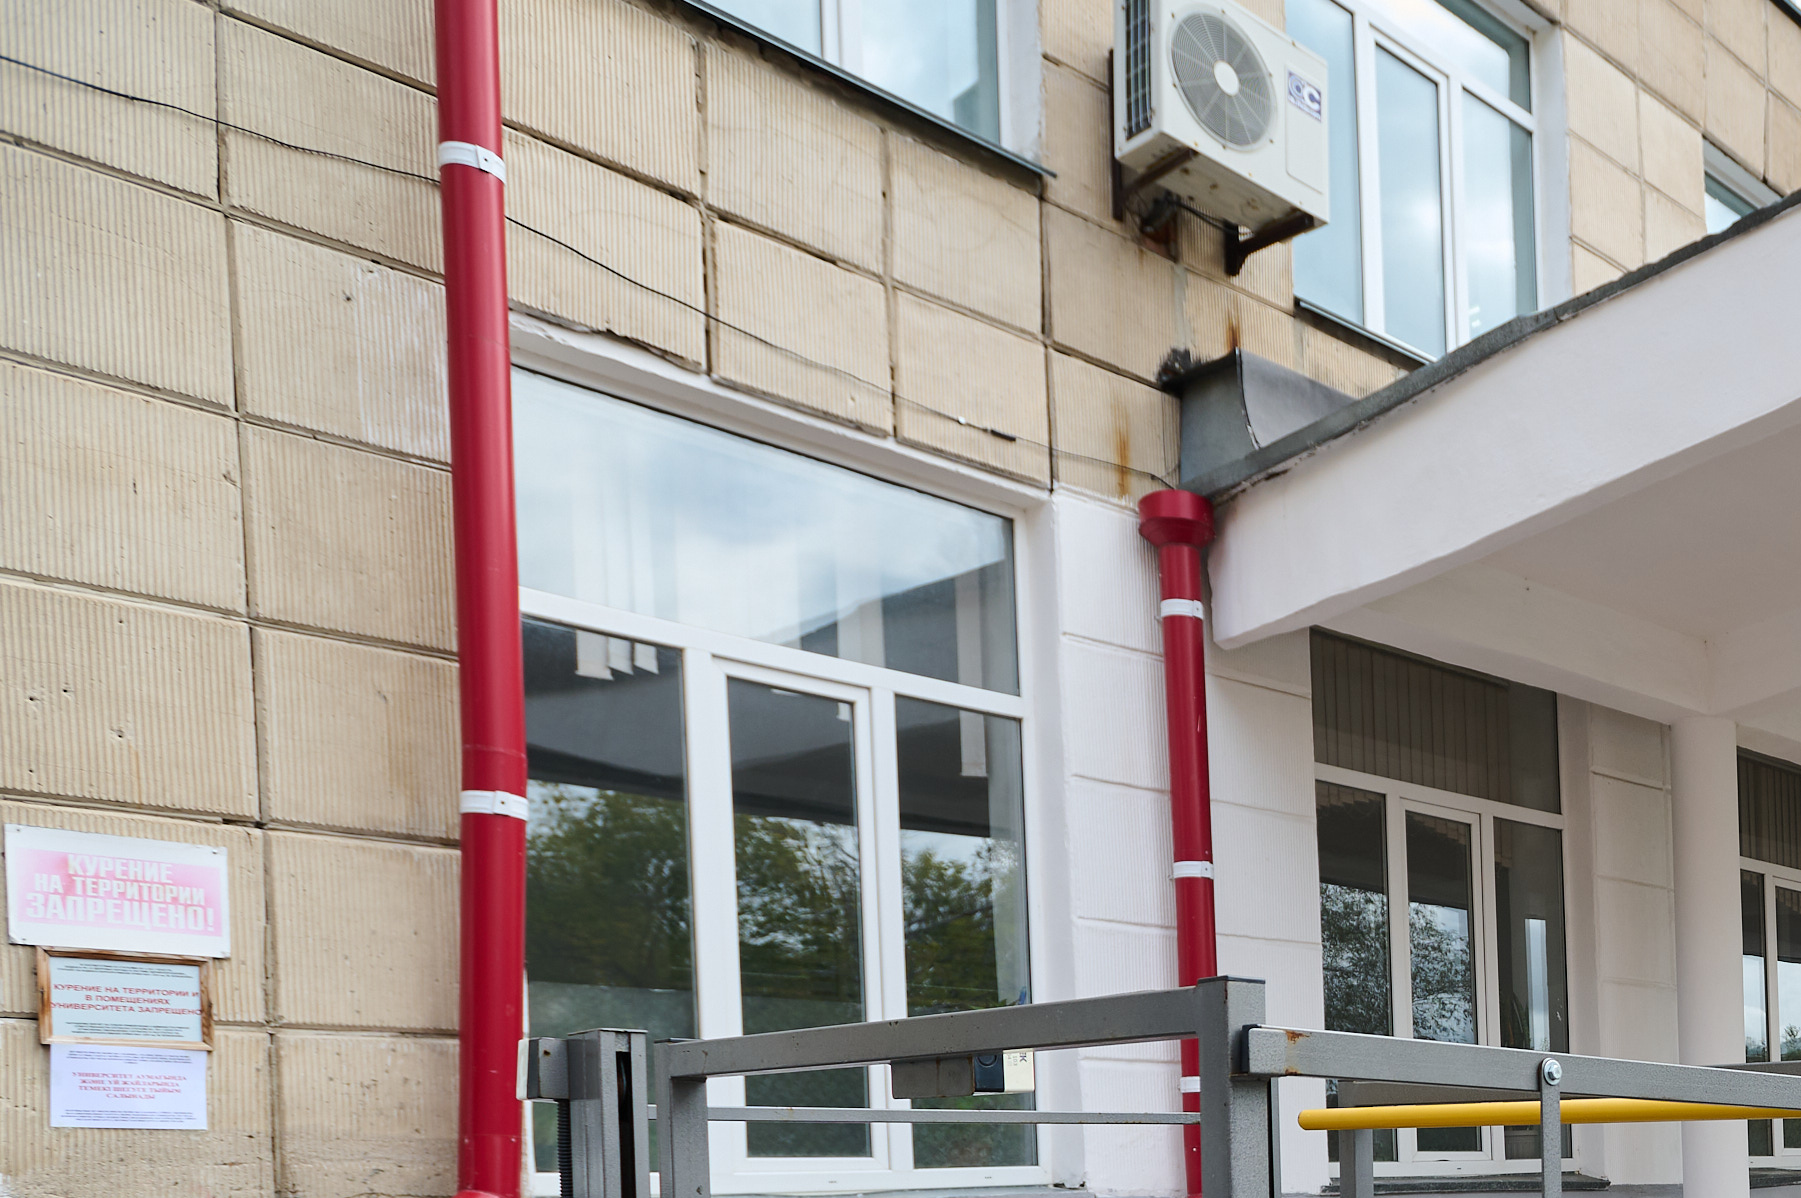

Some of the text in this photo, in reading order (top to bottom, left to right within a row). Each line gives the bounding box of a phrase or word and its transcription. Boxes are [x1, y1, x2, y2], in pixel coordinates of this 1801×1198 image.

[68, 853, 174, 884] КУРЕНИЕ
[34, 873, 205, 905] НА ТЕРРИТОРИИ
[26, 892, 214, 932] ЗАПРЕЩЕНО!
[53, 983, 102, 993] КУРЕНИЕ
[105, 986, 120, 994] НА
[122, 987, 189, 997] ТЕРРИТОРИИ
[95, 995, 170, 1005] ПОМЕЩЕНИЯХ
[50, 1001, 135, 1012] УНИВЕРСИТЕТА
